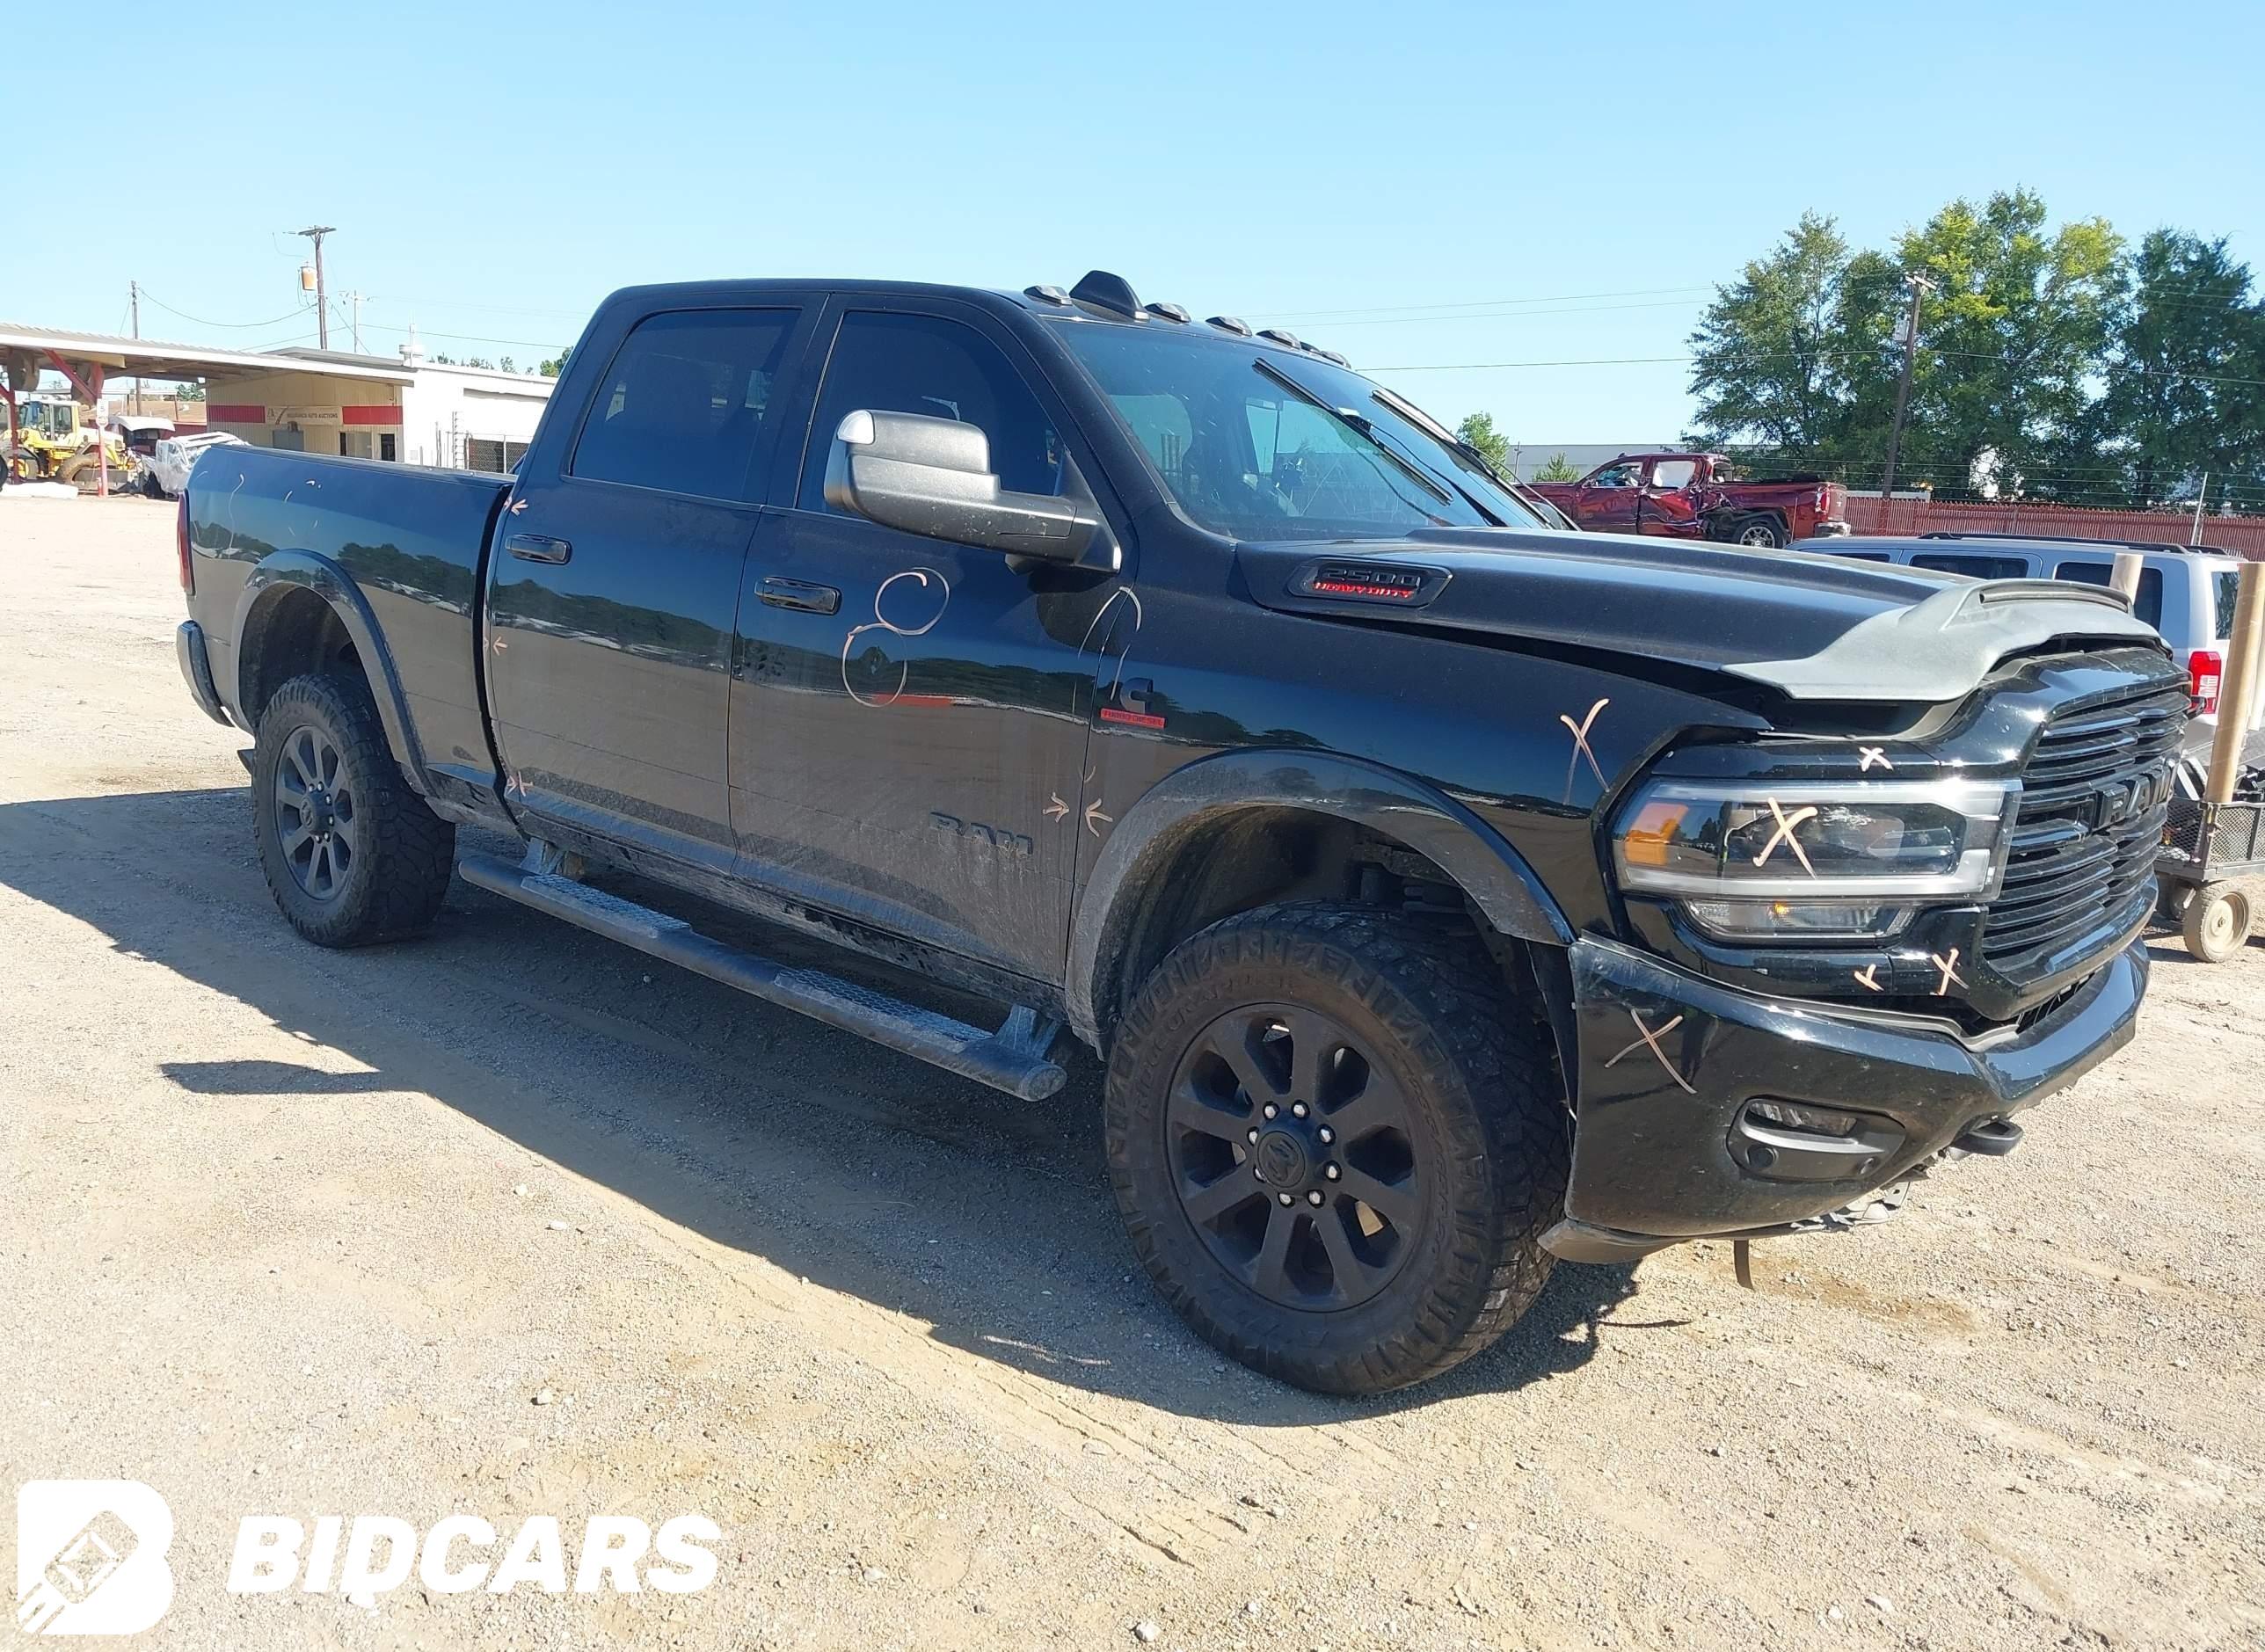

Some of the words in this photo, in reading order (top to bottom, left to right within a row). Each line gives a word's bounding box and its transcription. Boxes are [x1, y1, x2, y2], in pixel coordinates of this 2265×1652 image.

[1314, 581, 1366, 594] HEAVY
[1366, 586, 1415, 599] DUTY
[1322, 568, 1422, 587] 2500
[2094, 763, 2172, 831] RAM
[928, 811, 1034, 859] RAM
